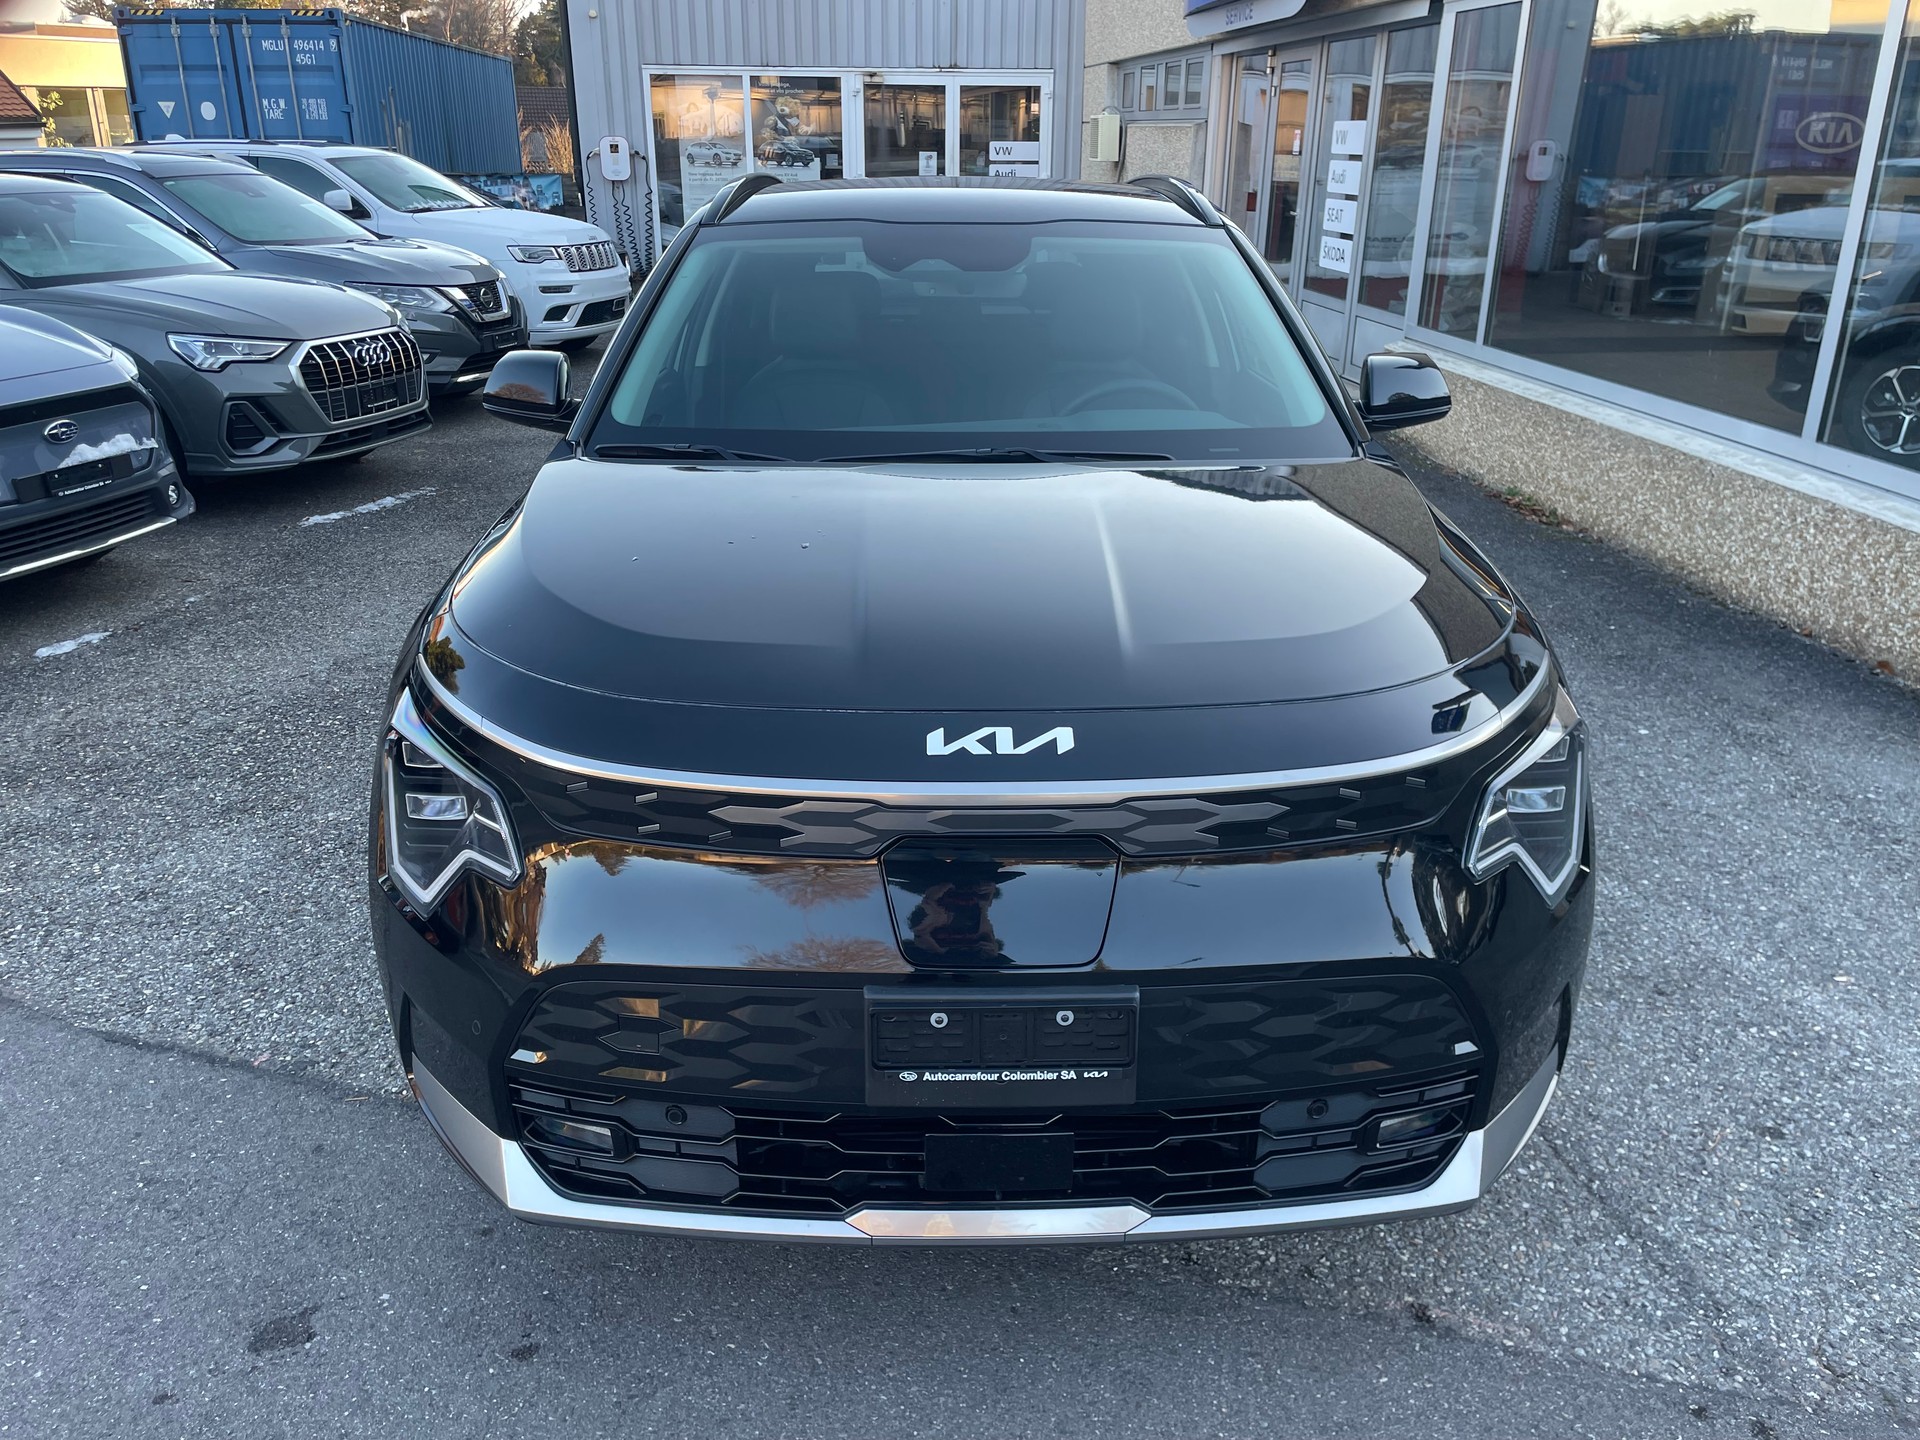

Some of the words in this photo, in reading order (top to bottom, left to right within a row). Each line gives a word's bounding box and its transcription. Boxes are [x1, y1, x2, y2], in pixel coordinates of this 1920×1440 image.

[1225, 3, 1254, 25] SERVICE
[262, 40, 284, 51] MGLU
[293, 40, 325, 51] 496414
[296, 54, 316, 65] 45G1
[264, 109, 285, 119] TARE
[1335, 130, 1349, 145] VW
[994, 146, 1013, 156] VW
[994, 168, 1017, 177] Audi
[1331, 169, 1347, 184] Audi
[1327, 208, 1344, 223] SEAT
[1322, 243, 1346, 264] ŠKODA
[926, 727, 1075, 756] KIA
[922, 1071, 999, 1082] Autocarrefour
[1001, 1070, 1058, 1082] Colombier
[1060, 1070, 1077, 1081] SA
